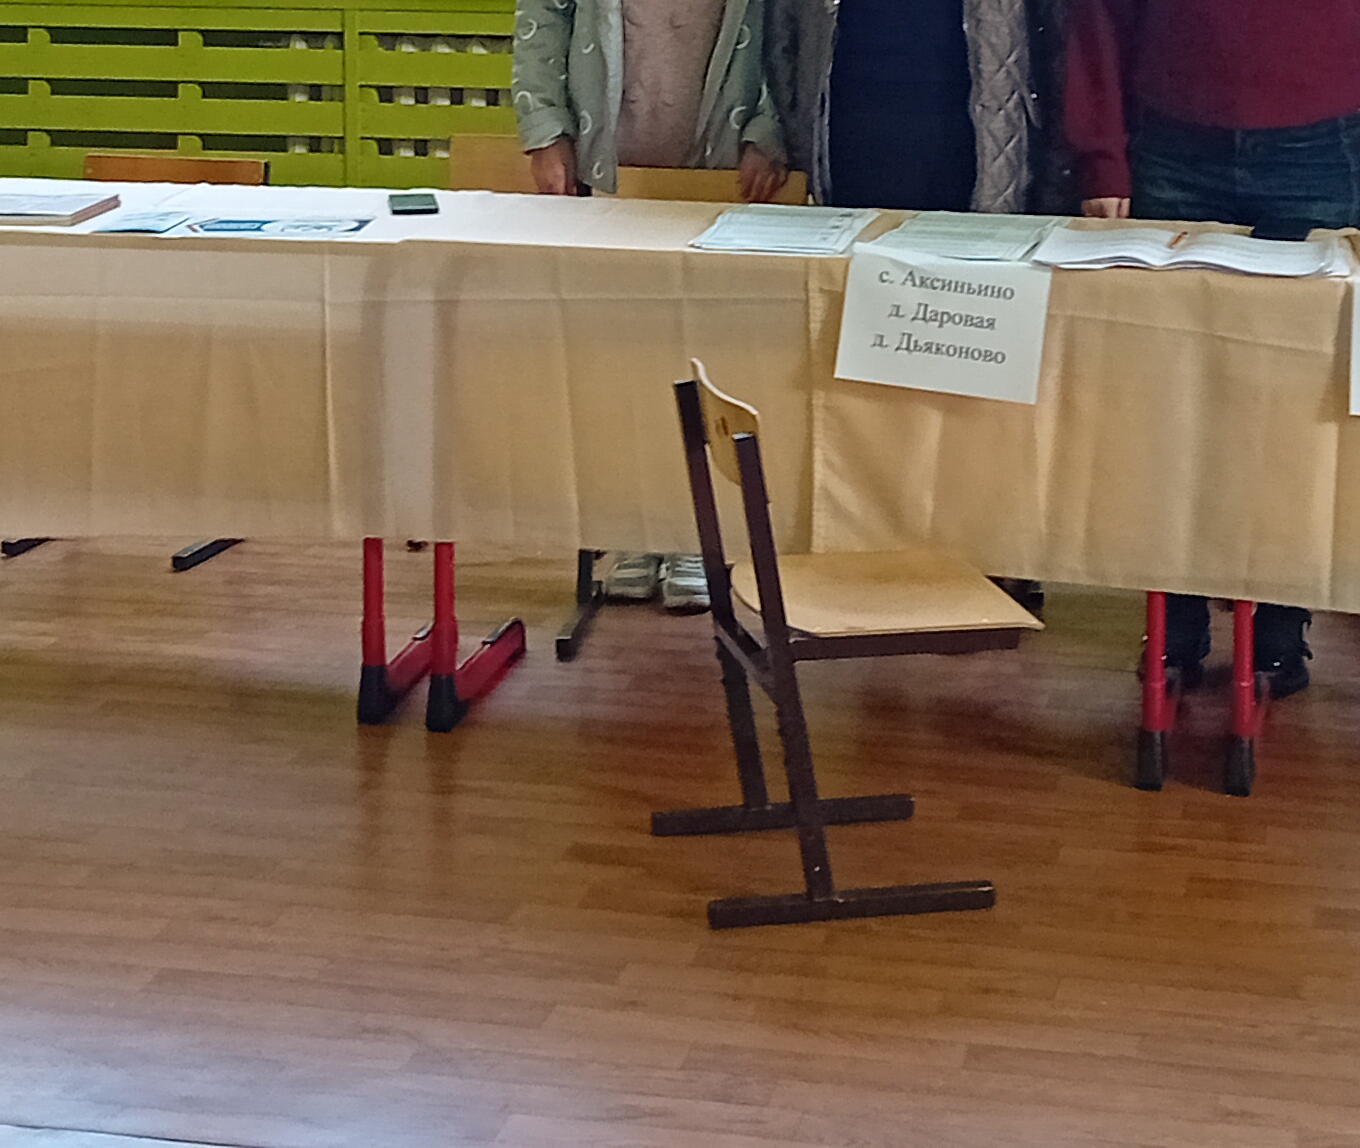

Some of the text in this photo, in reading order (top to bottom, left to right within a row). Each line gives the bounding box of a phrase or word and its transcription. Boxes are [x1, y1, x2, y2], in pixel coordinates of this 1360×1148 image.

[878, 269, 1016, 301] с. Аксиньино
[888, 301, 997, 331] д. Даровая
[870, 331, 1007, 364] д. Дьяконово
